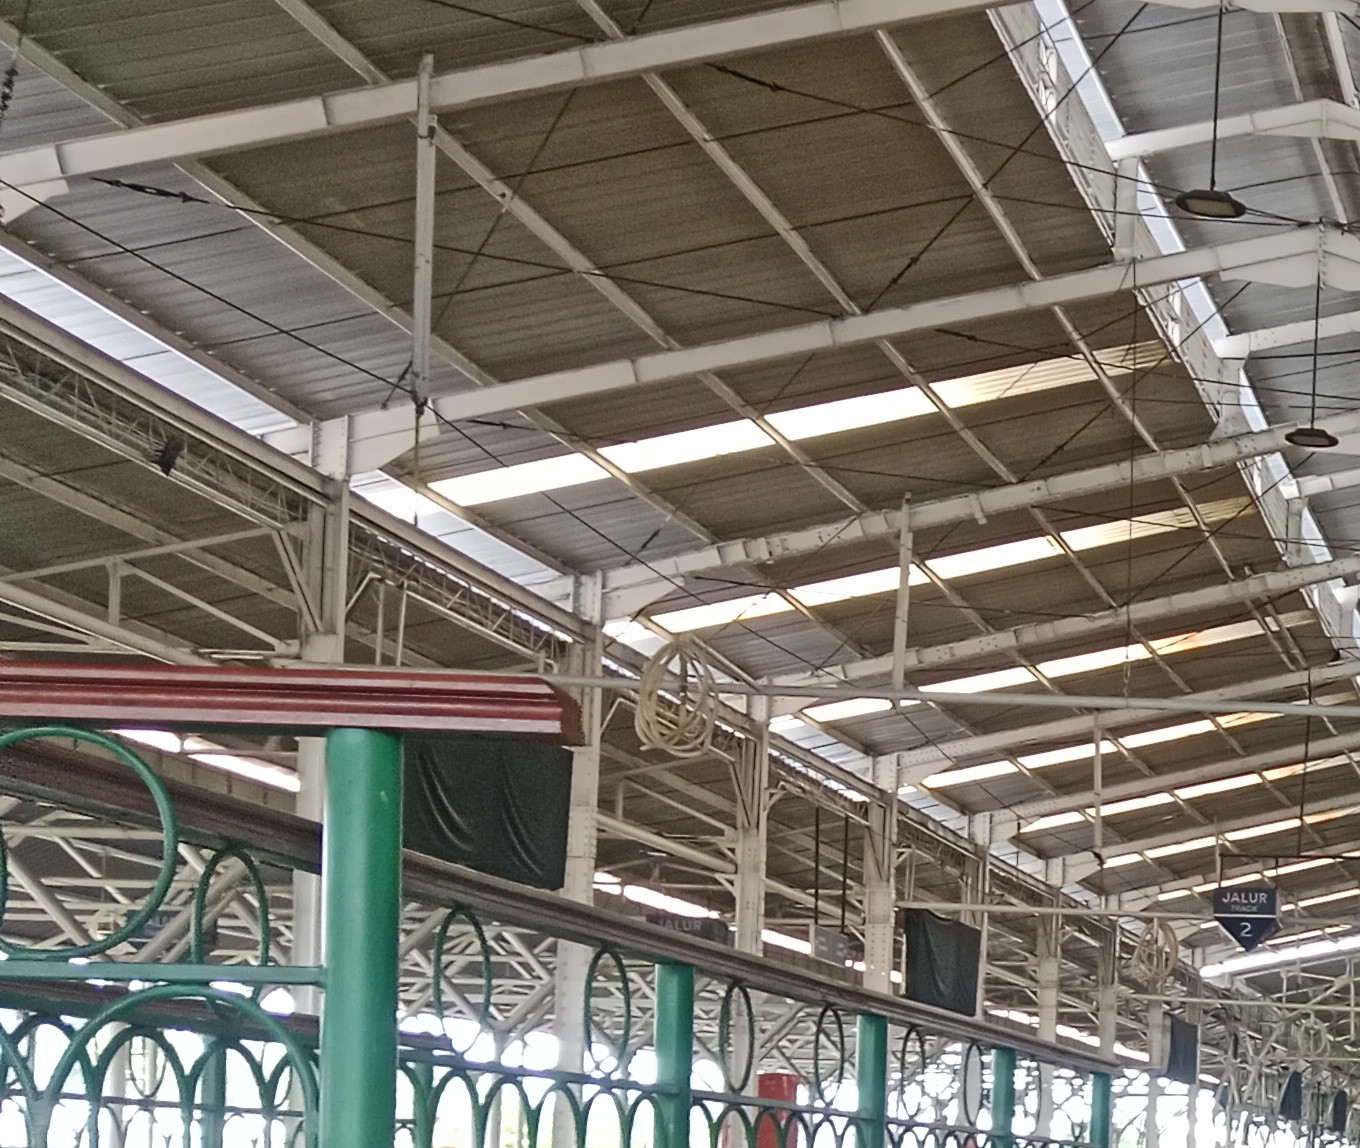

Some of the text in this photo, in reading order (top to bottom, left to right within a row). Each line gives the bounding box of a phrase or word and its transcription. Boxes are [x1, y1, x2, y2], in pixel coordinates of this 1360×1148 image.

[1222, 892, 1268, 904] JALUR
[1230, 904, 1259, 912] TRACK
[1239, 922, 1253, 937] 2
